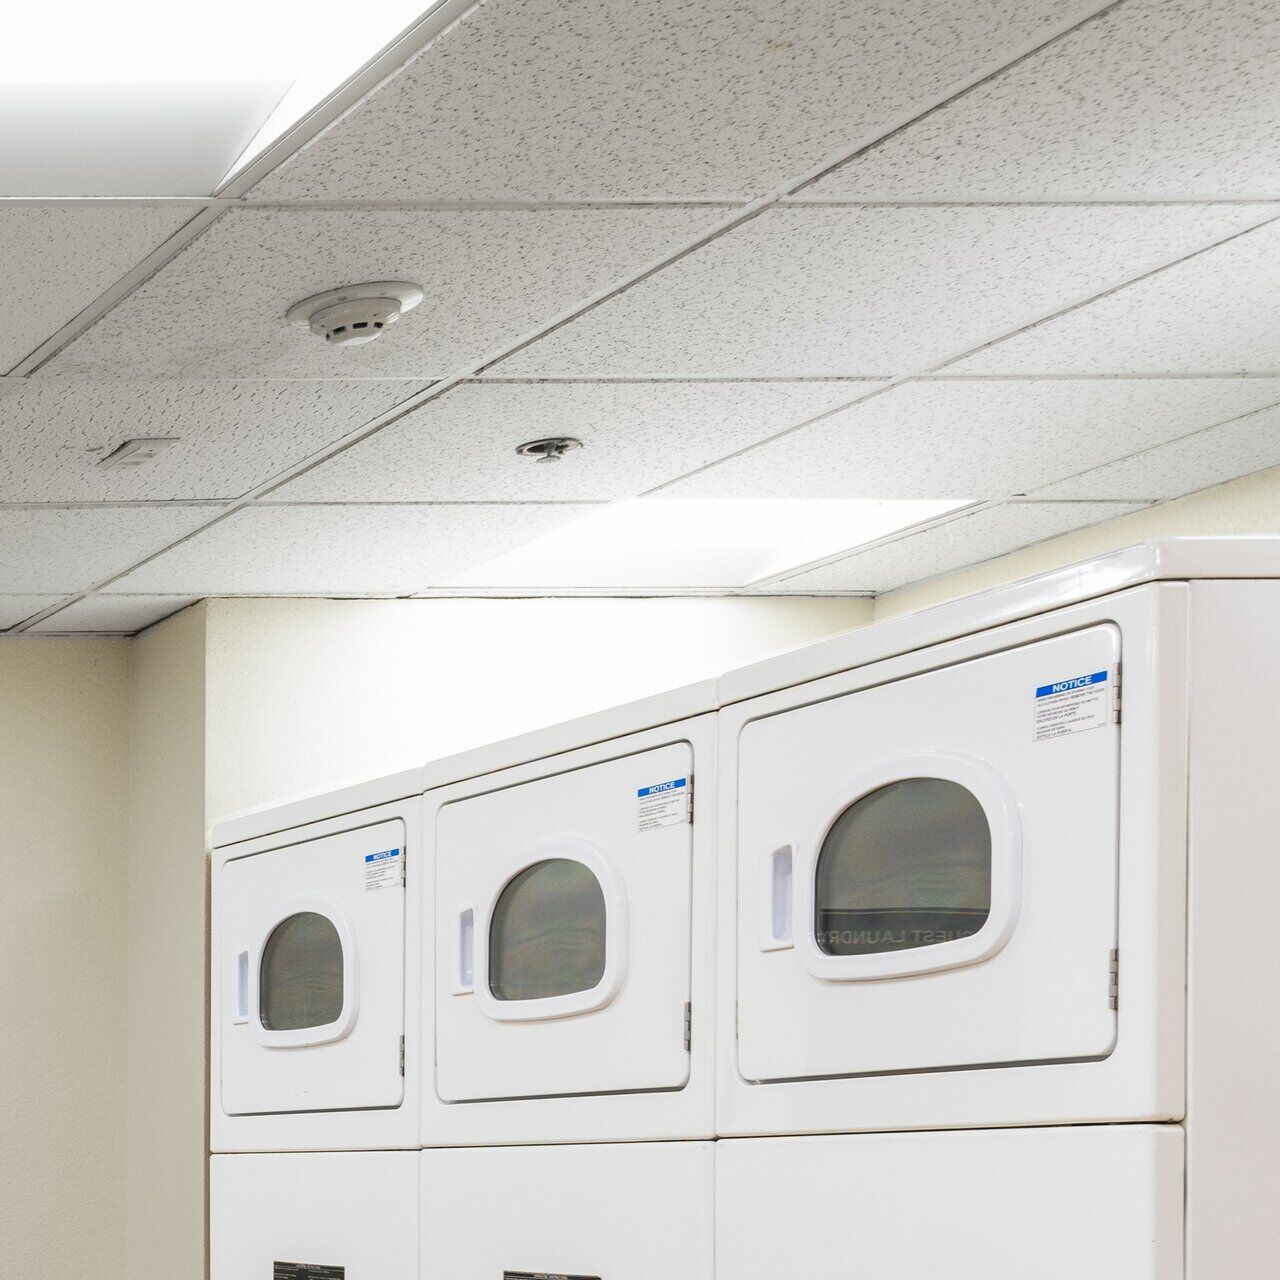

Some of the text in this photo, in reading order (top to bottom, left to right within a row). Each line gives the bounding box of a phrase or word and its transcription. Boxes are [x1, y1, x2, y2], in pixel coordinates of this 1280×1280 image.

[1052, 676, 1092, 692] NOTICE
[649, 782, 675, 794] NOTICE
[372, 851, 391, 860] NOTICE
